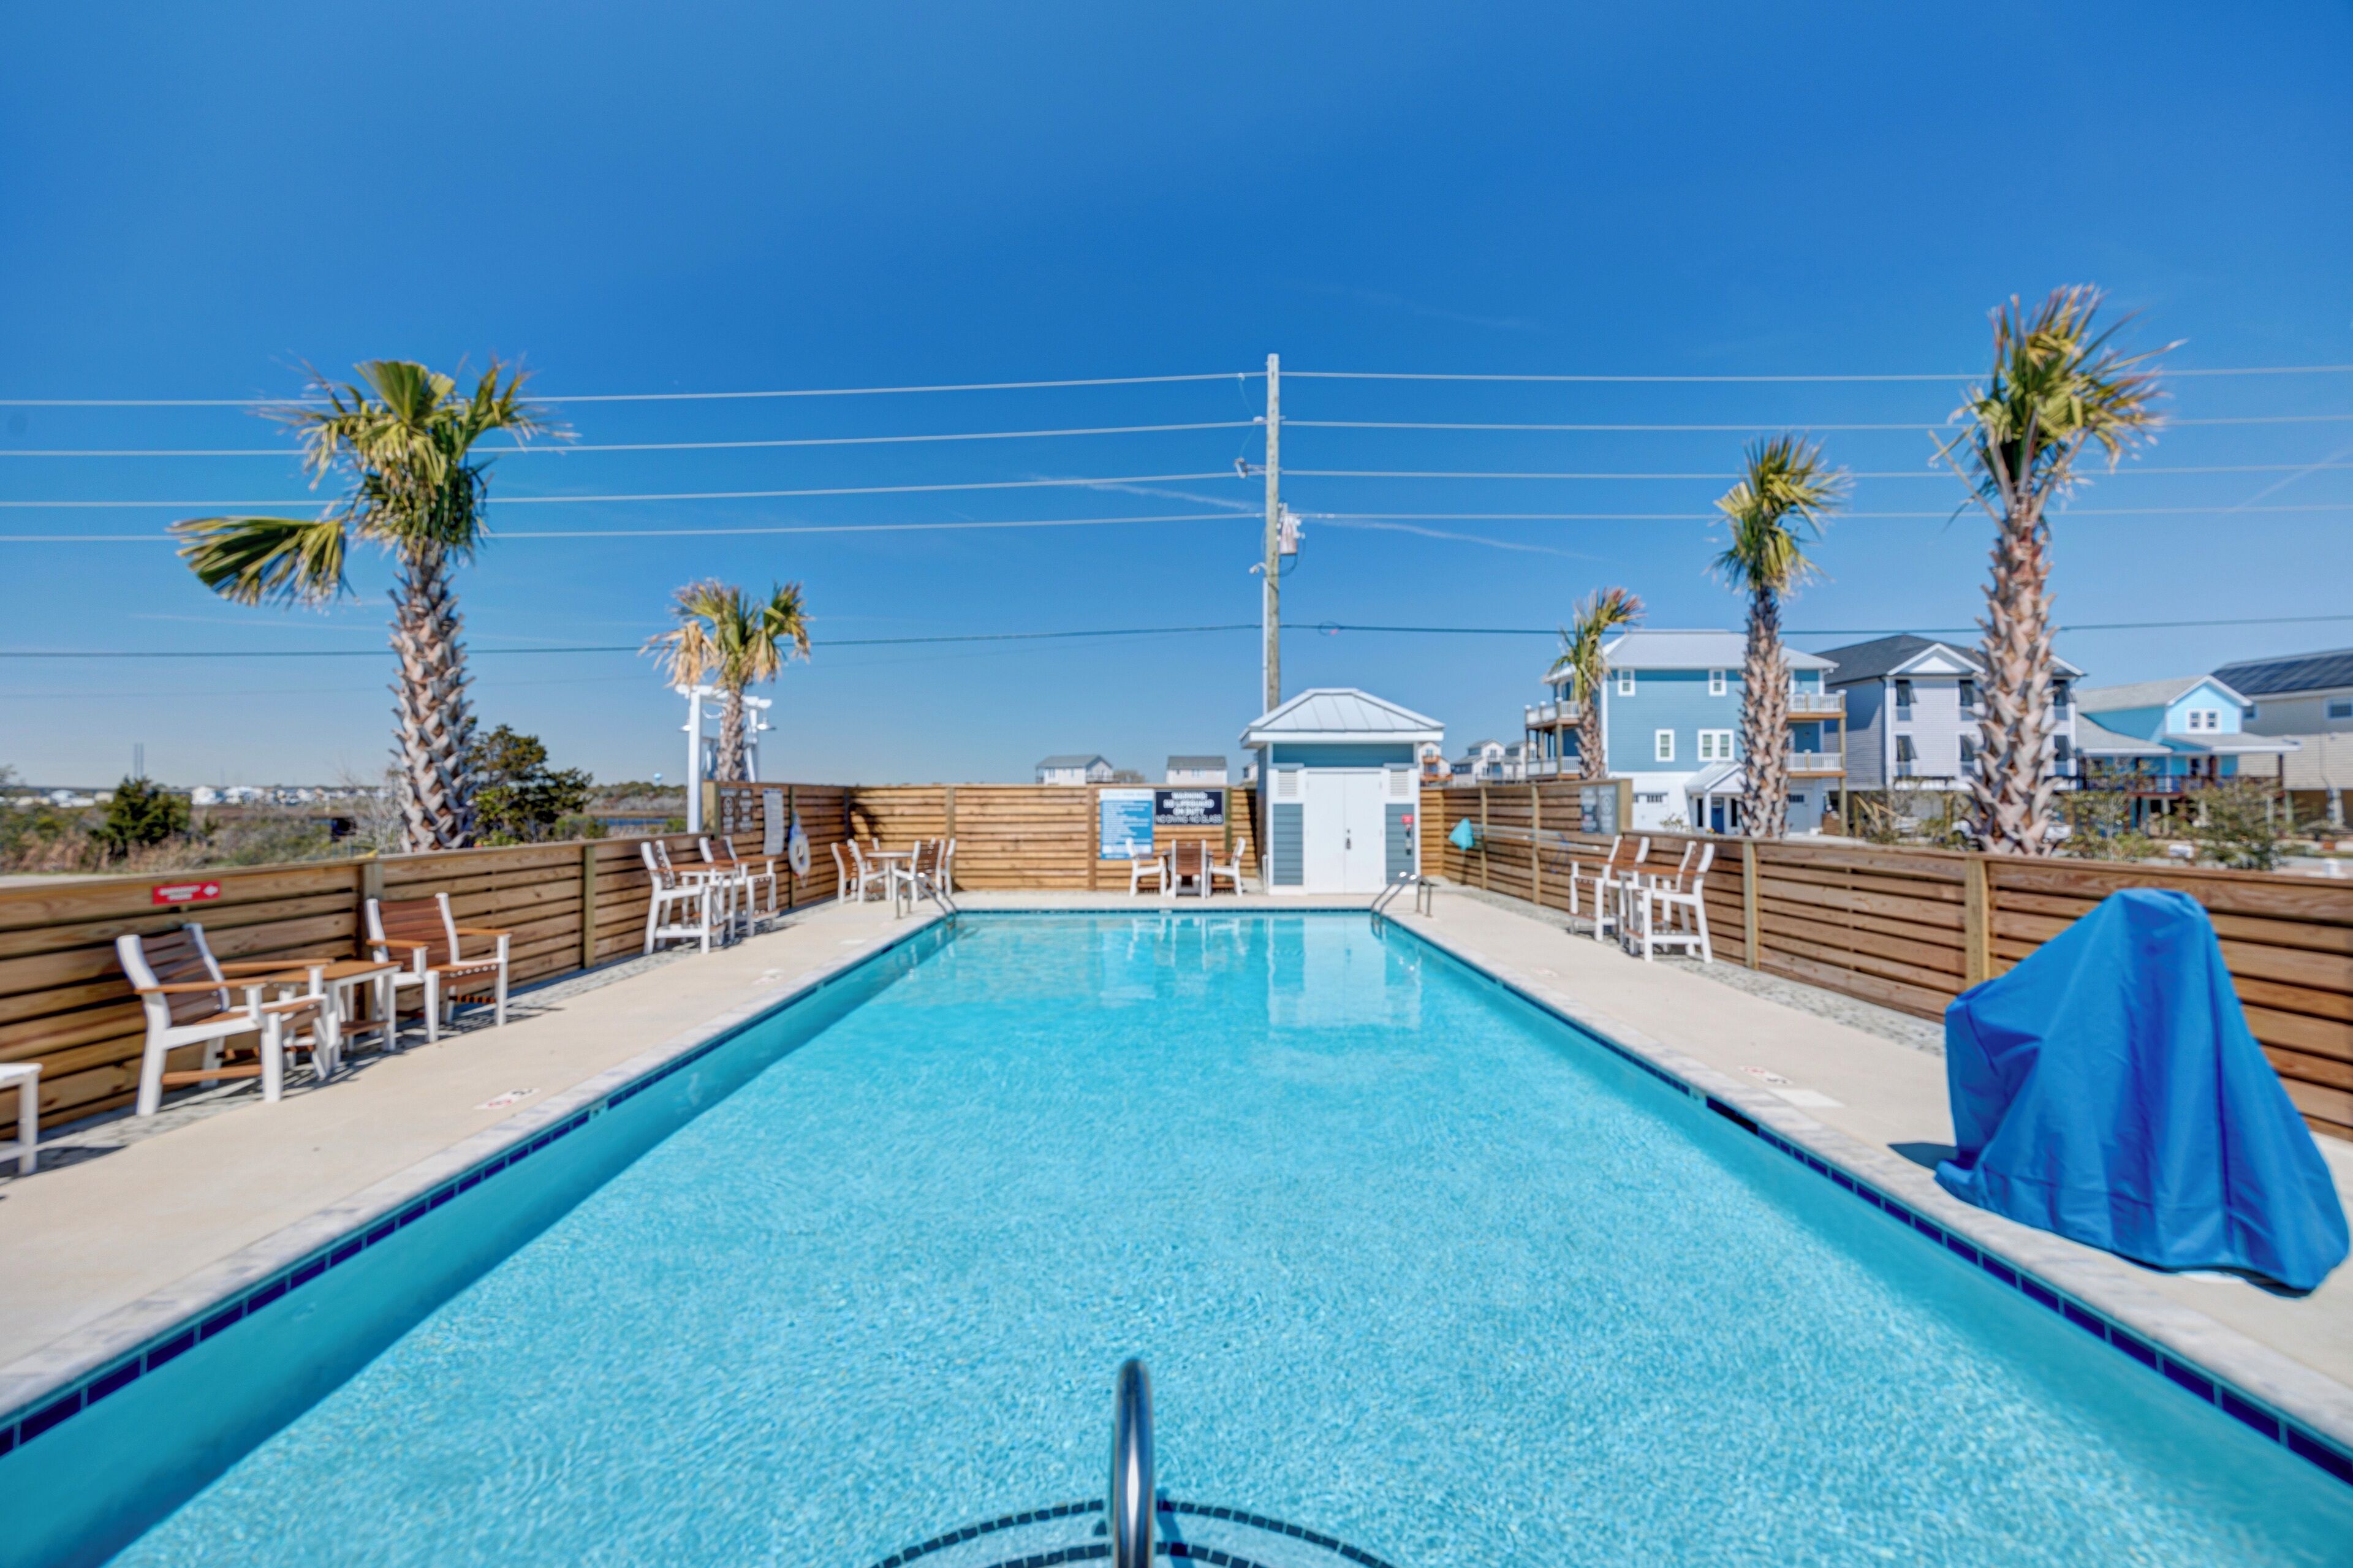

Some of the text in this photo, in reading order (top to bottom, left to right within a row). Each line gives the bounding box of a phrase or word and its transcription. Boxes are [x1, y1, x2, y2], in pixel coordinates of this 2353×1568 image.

[1163, 799, 1175, 808] NO
[1155, 814, 1224, 824] NO DIVING NO GLASS
